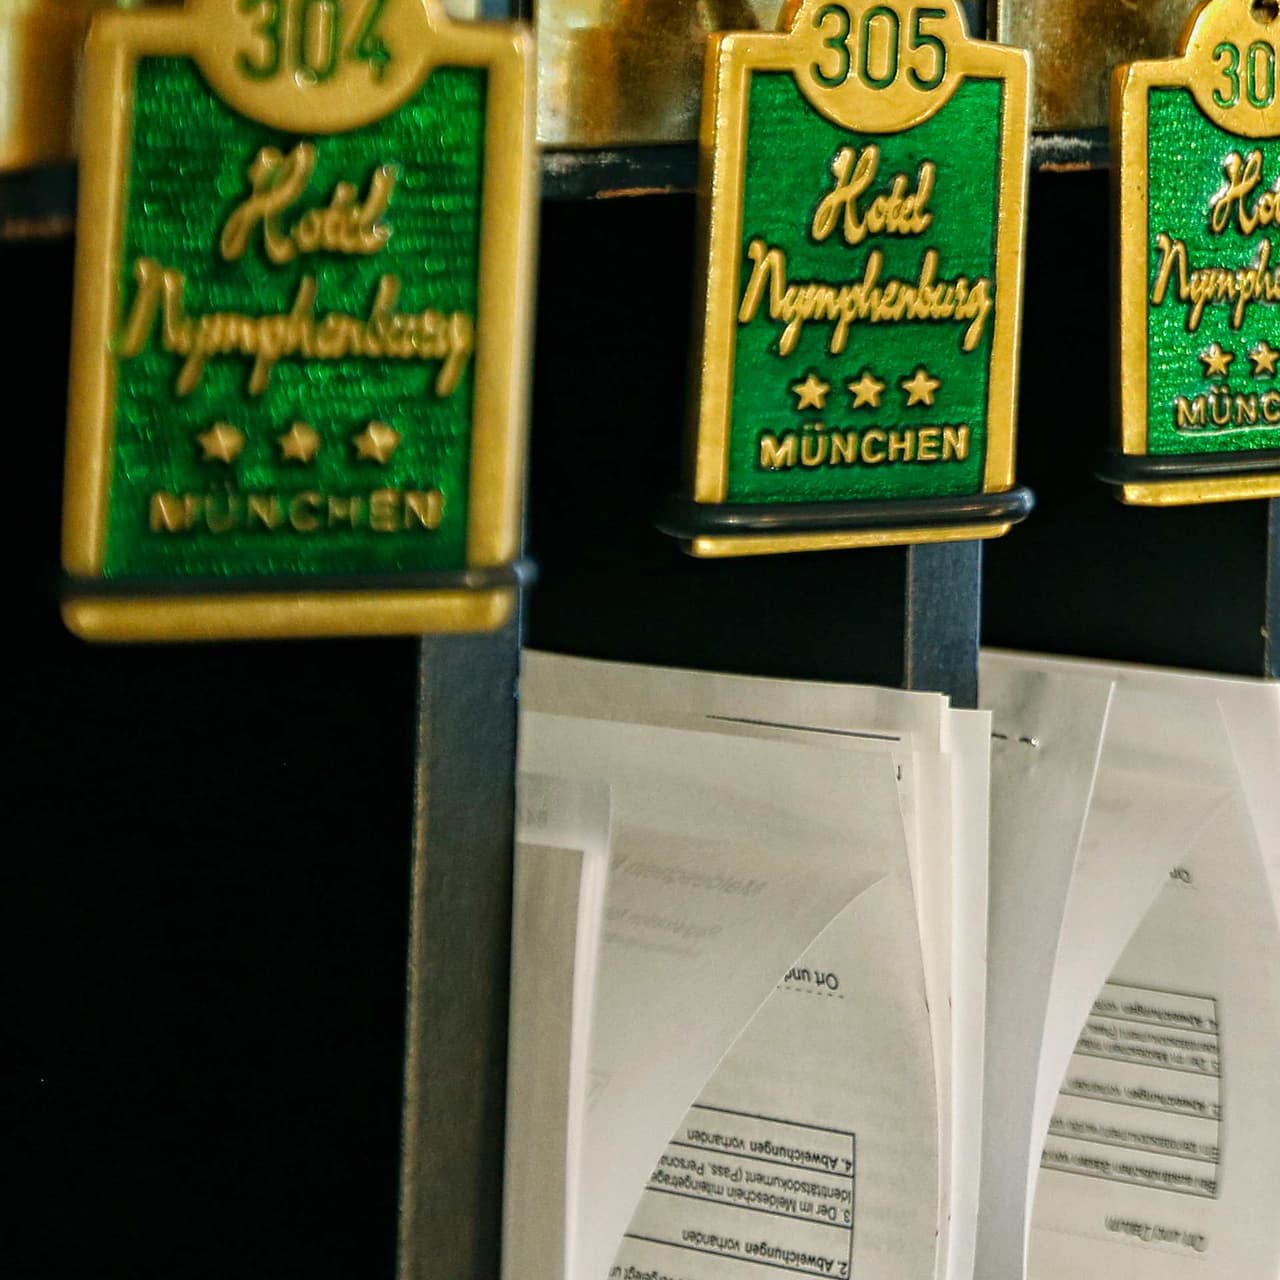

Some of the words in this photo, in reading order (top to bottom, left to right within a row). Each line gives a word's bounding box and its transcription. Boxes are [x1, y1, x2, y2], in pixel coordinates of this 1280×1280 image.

[810, 3, 947, 91] 305
[221, 142, 399, 264] Hotel
[812, 144, 934, 245] Hotel
[738, 238, 990, 357] Nymphenburg
[114, 257, 473, 397] Nymphenburg
[760, 422, 971, 469] MÜNCHEN
[149, 482, 446, 532] MÜNCHEN
[814, 969, 839, 990] Ort
[687, 1128, 745, 1150] vorhanden
[750, 1140, 839, 1171] Abweichungen
[841, 1157, 854, 1172] 4.
[727, 1187, 797, 1213] Meldeschein
[799, 1200, 814, 1215] im
[815, 1204, 837, 1220] Der
[682, 1229, 741, 1252] vorhanden
[745, 1242, 834, 1274] Abweichungen
[837, 1260, 848, 1276] 2.
